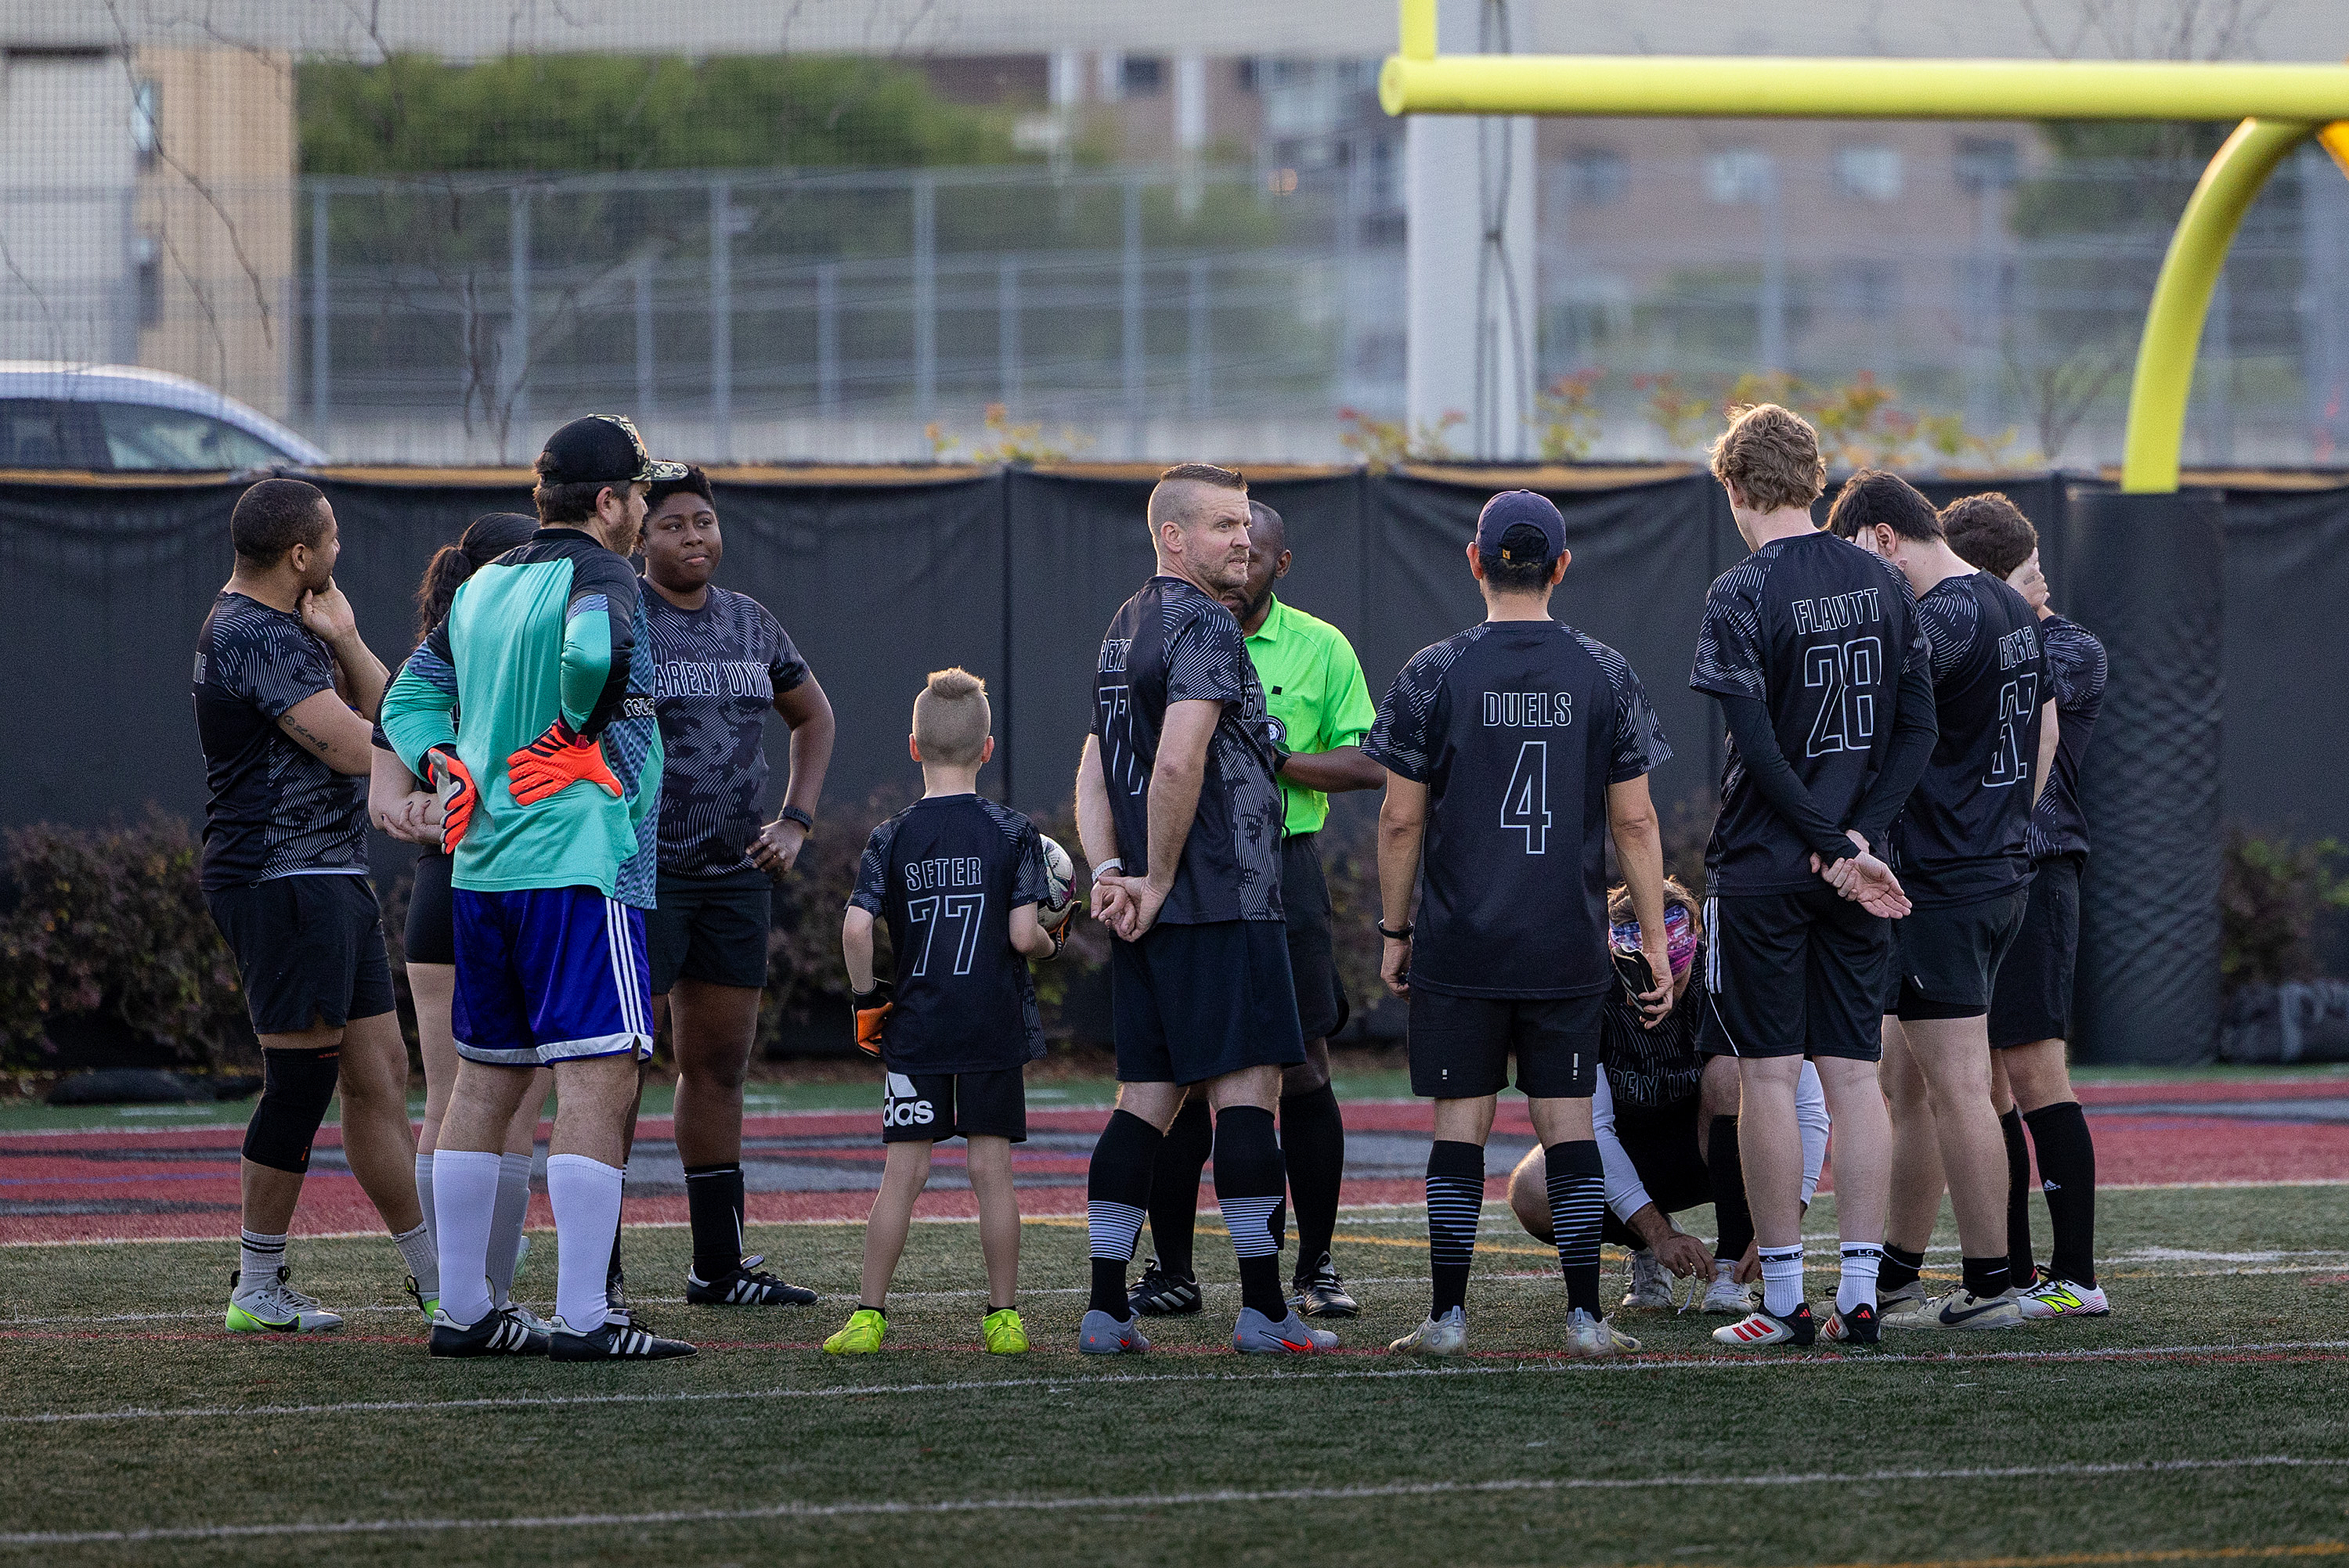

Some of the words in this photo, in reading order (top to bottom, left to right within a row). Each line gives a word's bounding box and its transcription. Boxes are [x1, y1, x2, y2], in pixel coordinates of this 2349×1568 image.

[652, 661, 720, 697] ARELY
[1804, 636, 1882, 758] 28
[1483, 691, 1571, 727] DUELS
[1500, 741, 1552, 855] 4
[904, 856, 983, 892] SETER
[907, 892, 985, 977] 77
[1609, 1067, 1659, 1107] RELY
[882, 1096, 934, 1127] das
